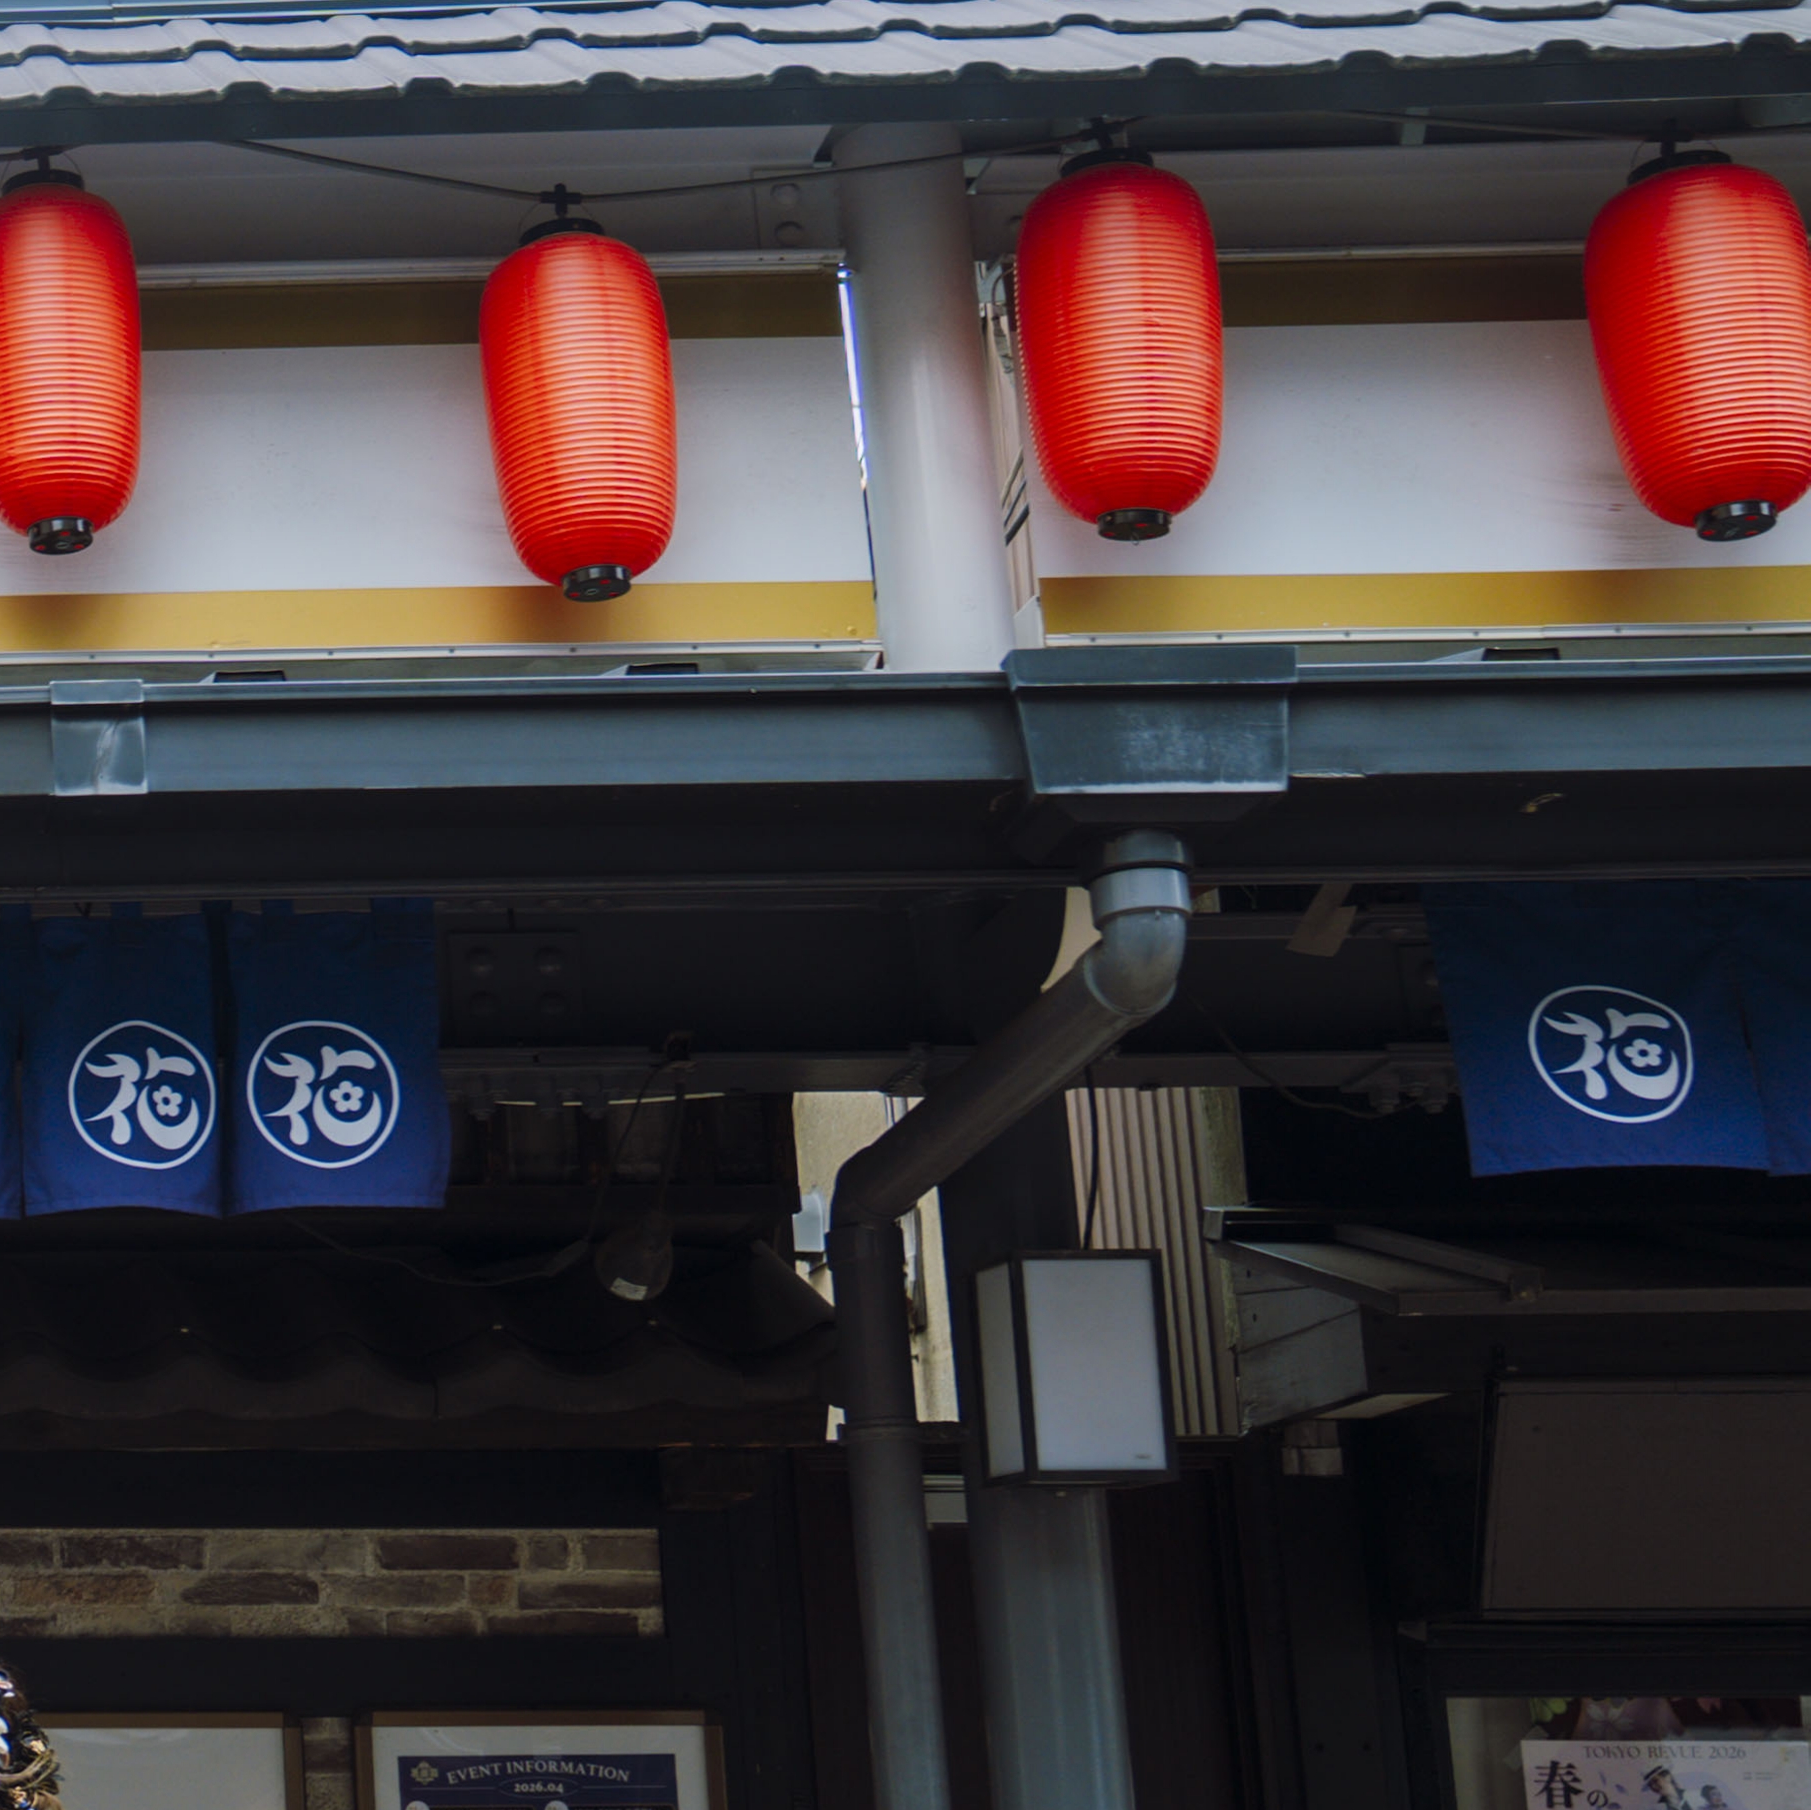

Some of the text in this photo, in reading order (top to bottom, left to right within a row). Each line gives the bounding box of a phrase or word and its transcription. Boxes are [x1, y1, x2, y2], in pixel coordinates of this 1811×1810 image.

[1583, 1745, 1747, 1759] TOKYO REVUE 2026
[446, 1759, 631, 1785] EVENT INFORMATION
[514, 1781, 564, 1794] 2026.04
[1533, 1760, 1609, 1809] 春の
